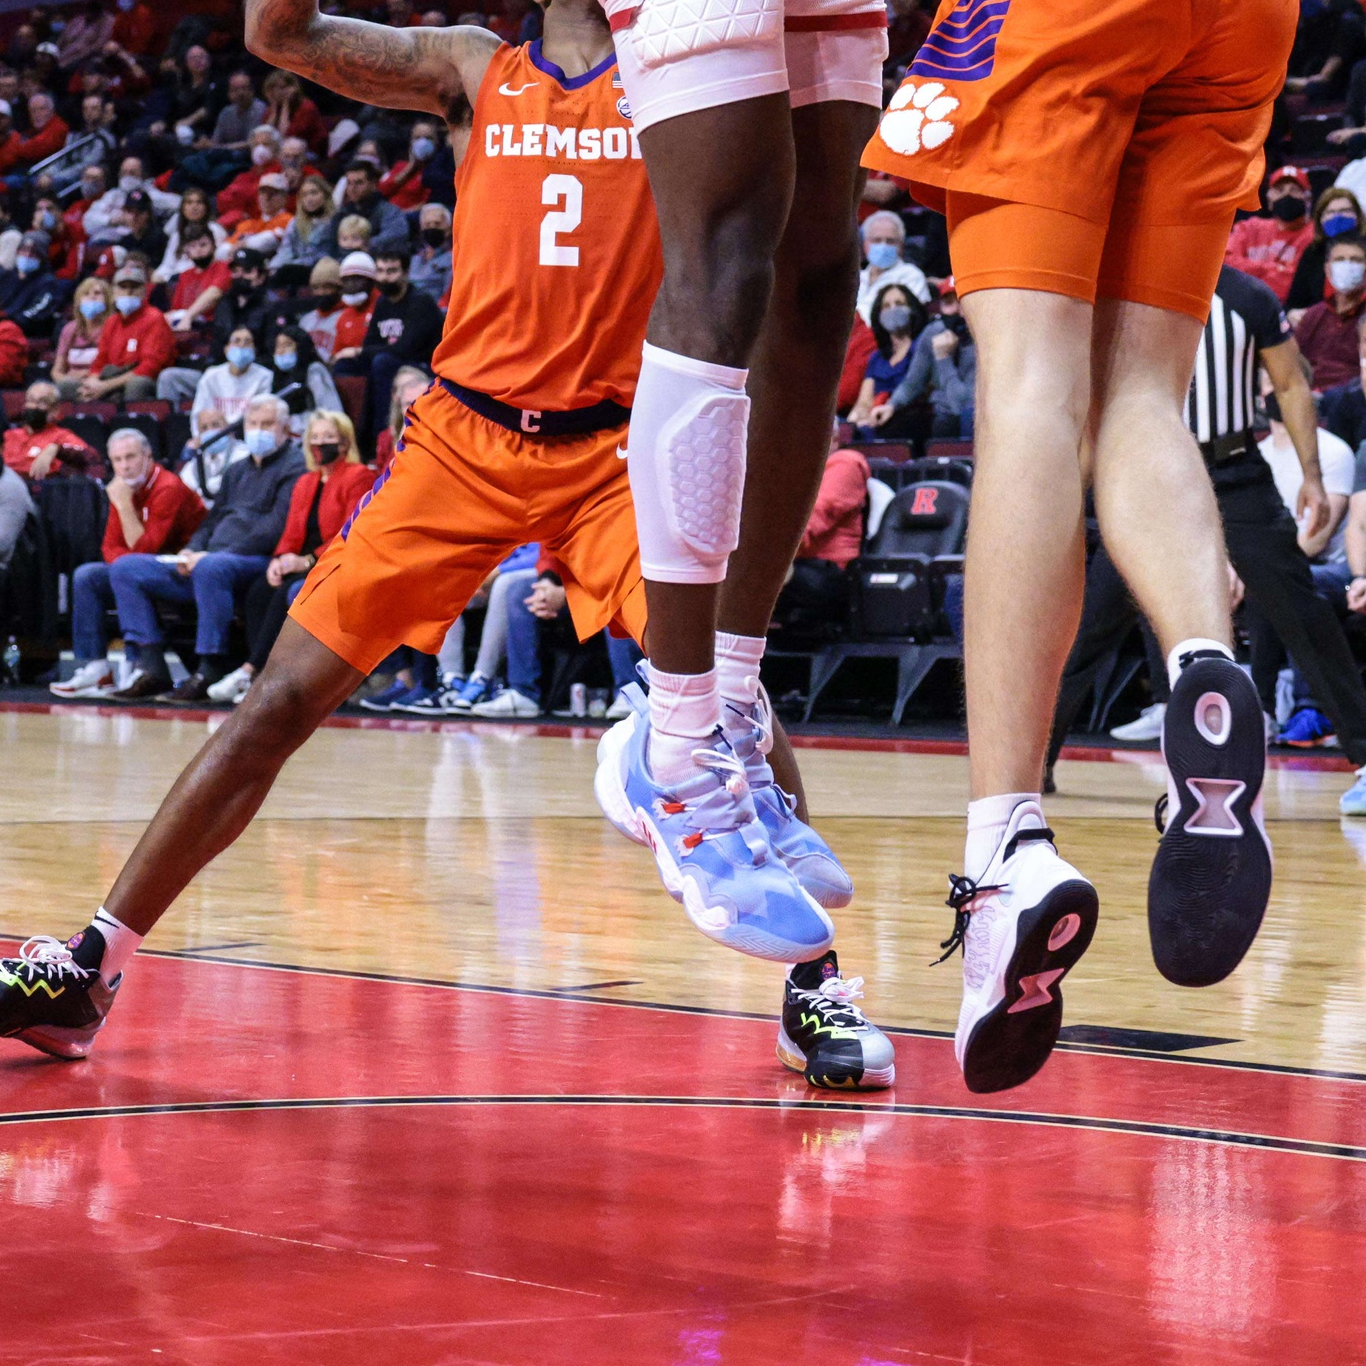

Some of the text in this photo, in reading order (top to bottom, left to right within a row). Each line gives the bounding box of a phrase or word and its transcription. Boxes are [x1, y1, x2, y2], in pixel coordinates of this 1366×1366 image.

[539, 174, 583, 267] 2
[520, 410, 542, 433] C
[910, 487, 939, 515] R
